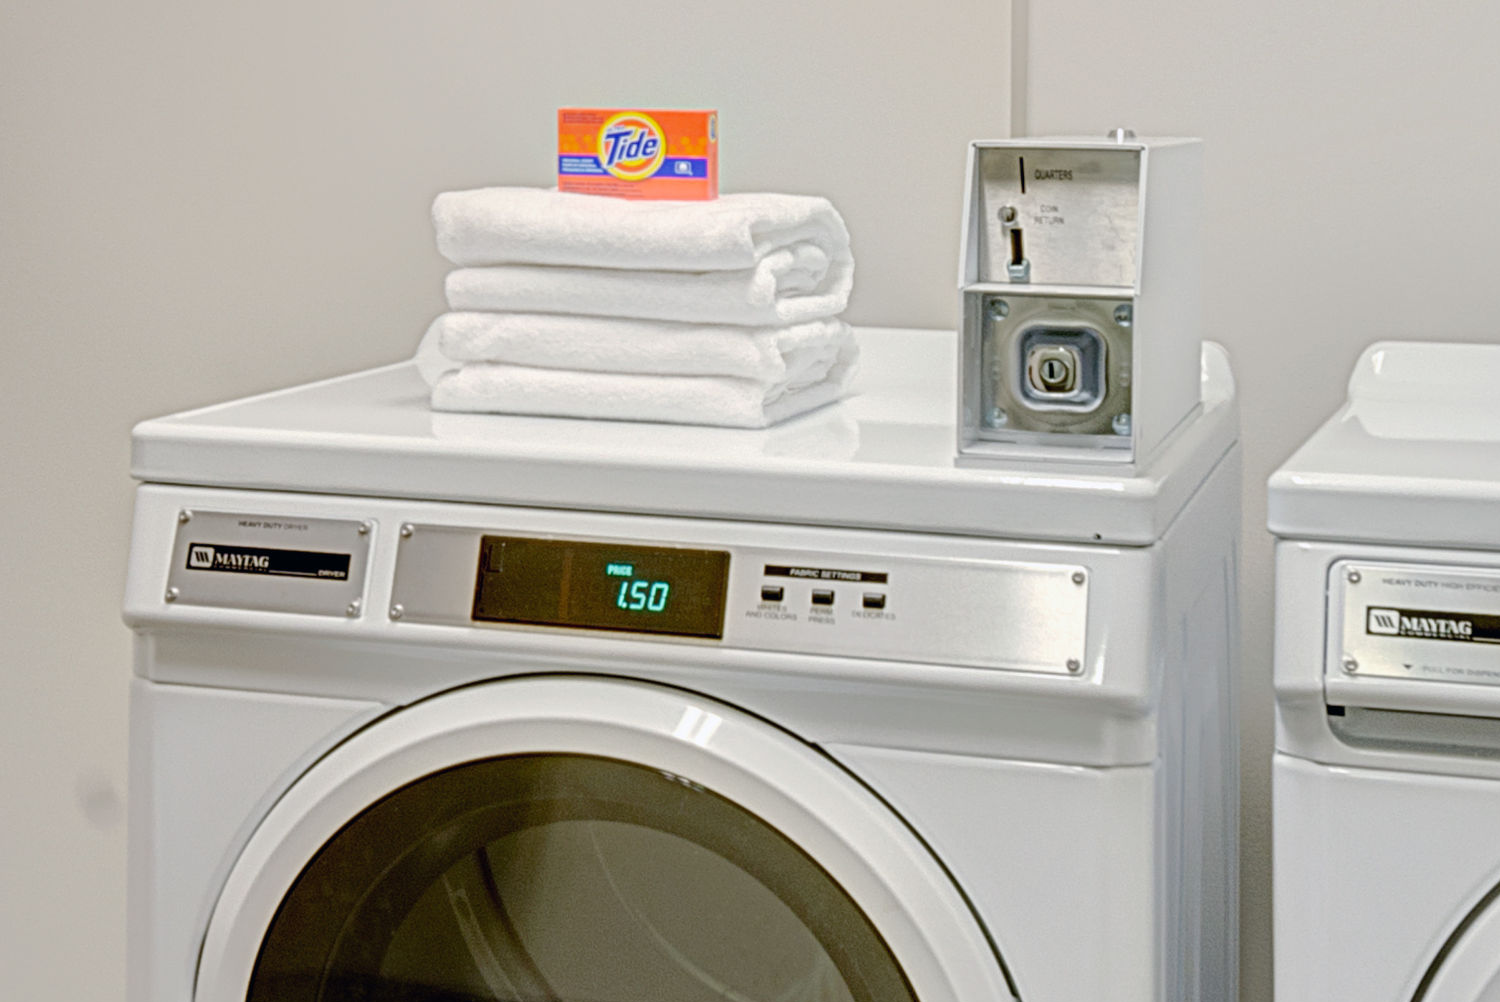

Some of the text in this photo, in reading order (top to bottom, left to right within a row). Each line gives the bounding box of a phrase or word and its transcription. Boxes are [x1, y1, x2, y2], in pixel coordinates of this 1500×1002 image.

[605, 130, 658, 167] Tide
[1034, 169, 1073, 181] QUARTERS
[214, 552, 270, 569] MAYTAG
[607, 563, 633, 577] PRICE
[789, 568, 862, 580] FABRIC SETTINGS
[617, 581, 669, 612] 1.50
[1400, 615, 1473, 636] MAYTAG
